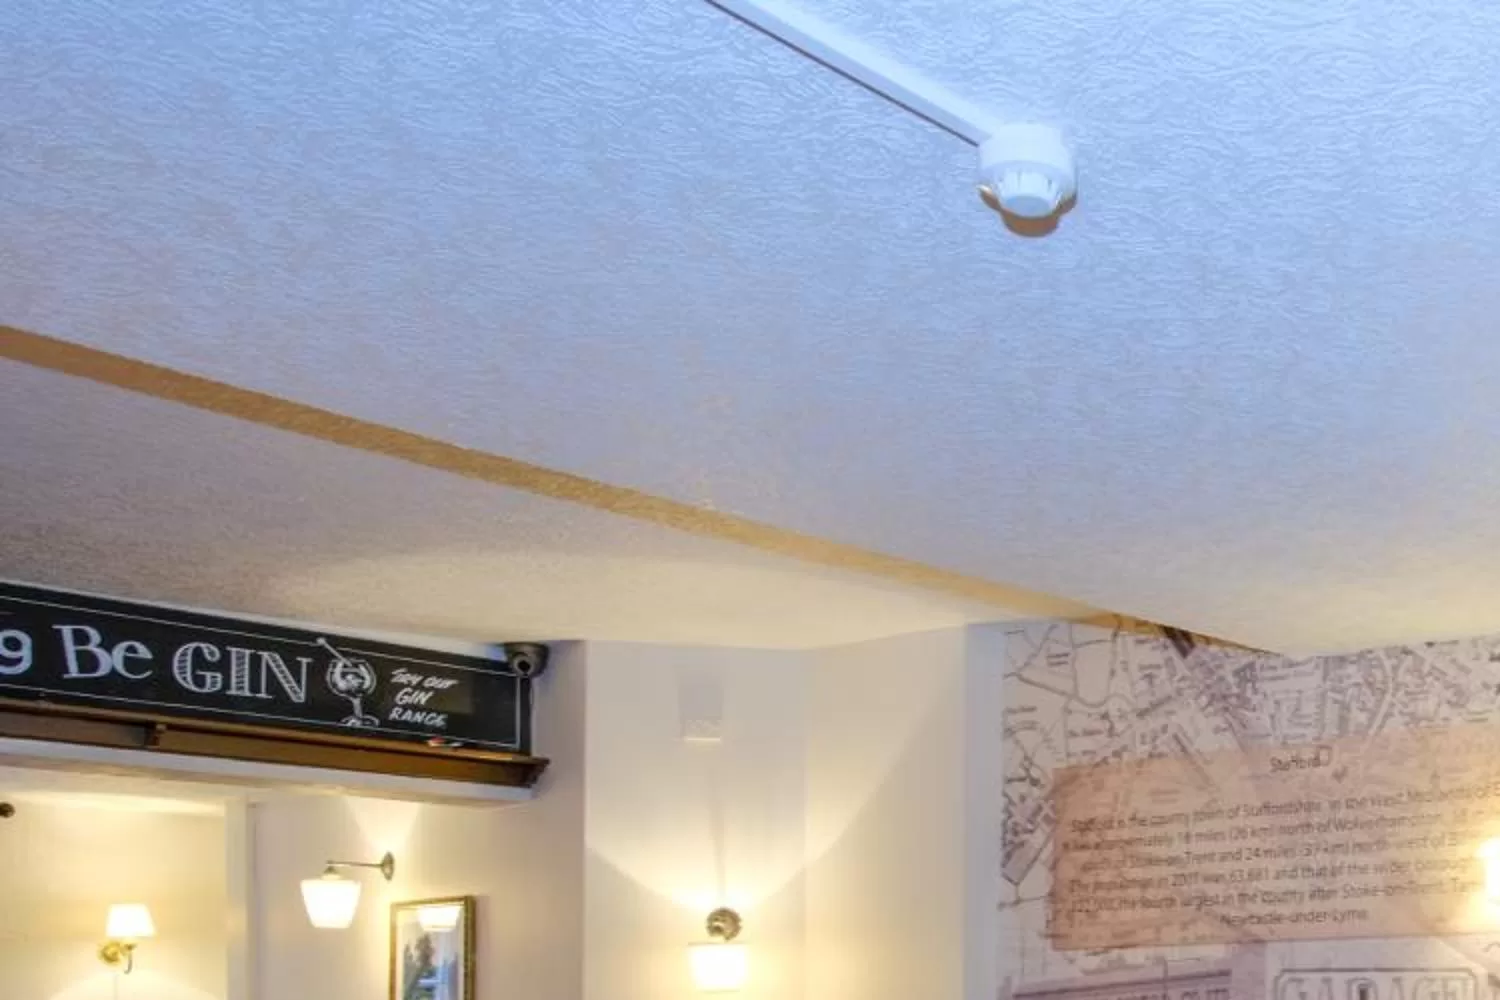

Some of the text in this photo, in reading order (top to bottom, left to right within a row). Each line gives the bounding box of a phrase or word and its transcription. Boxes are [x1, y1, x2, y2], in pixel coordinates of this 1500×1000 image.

[52, 624, 152, 679] Be
[172, 641, 312, 703] GIN
[394, 687, 434, 705] GIN
[388, 706, 448, 729] RANGE
